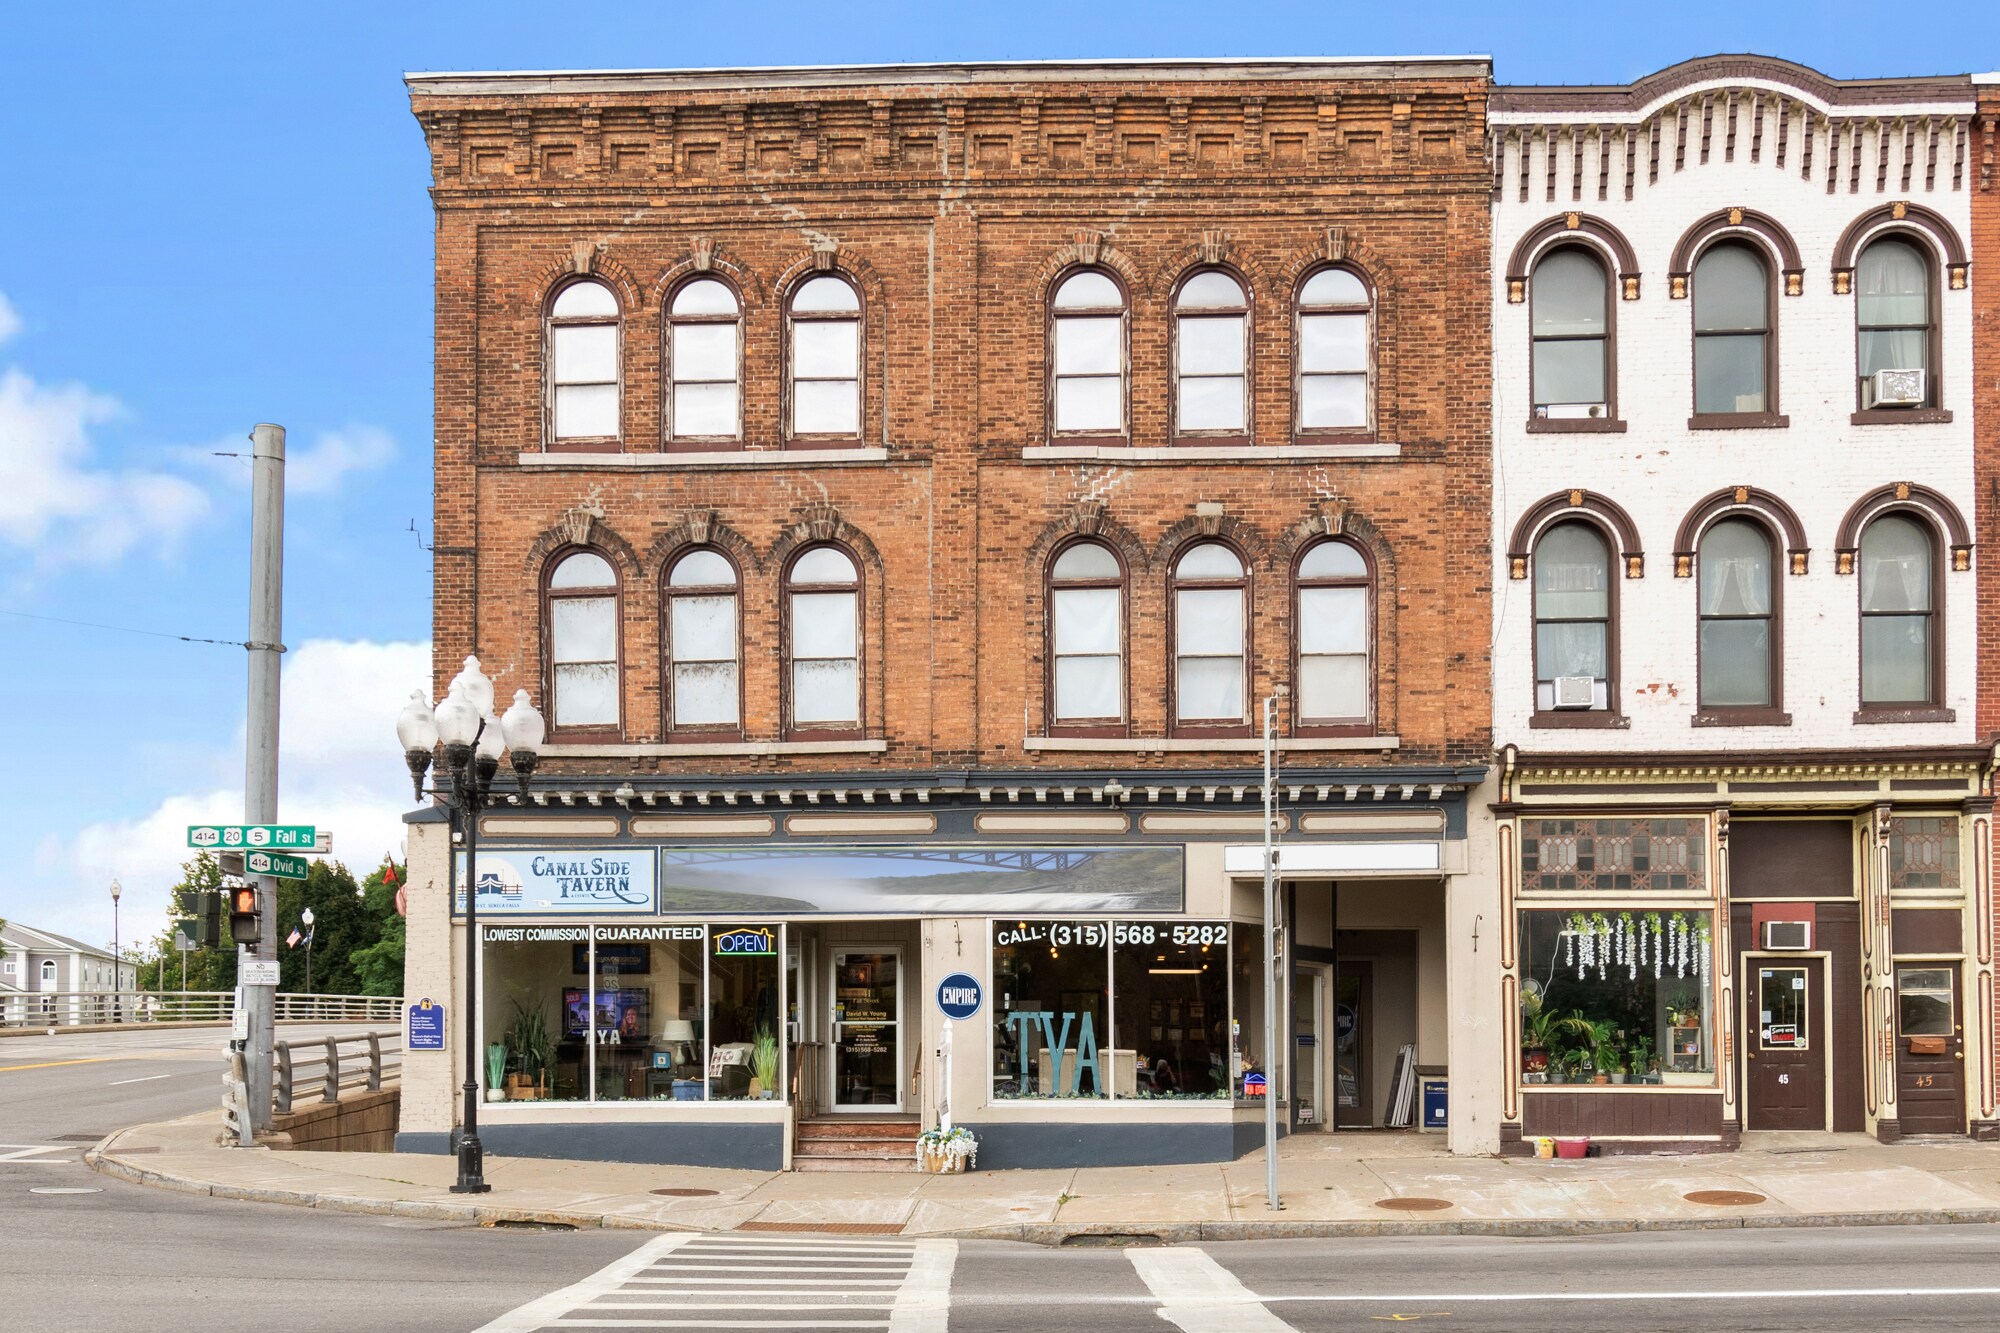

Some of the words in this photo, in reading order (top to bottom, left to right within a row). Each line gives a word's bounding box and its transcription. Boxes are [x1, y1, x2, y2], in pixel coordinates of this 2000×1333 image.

[195, 832, 216, 841] 414
[226, 831, 240, 841] 20
[254, 831, 263, 841] 5
[275, 830, 297, 844] Fall
[251, 858, 268, 868] 414
[273, 857, 294, 873] Ovid
[556, 877, 631, 899] TAVERN
[484, 928, 525, 941] LOWEST
[526, 928, 589, 941] COMMISSION
[594, 927, 704, 940] GUARANTEED
[997, 926, 1046, 946] CALL:
[1049, 923, 1107, 948] (315)
[1114, 925, 1155, 945] 568
[1172, 925, 1227, 945] 5282
[719, 934, 767, 952] OPEN
[942, 988, 977, 1004] EMPIRE
[1772, 1033, 1794, 1041] CLOSED
[1007, 1011, 1101, 1095] TYA
[1778, 1074, 1789, 1084] 45
[1915, 1075, 1933, 1088] 45
